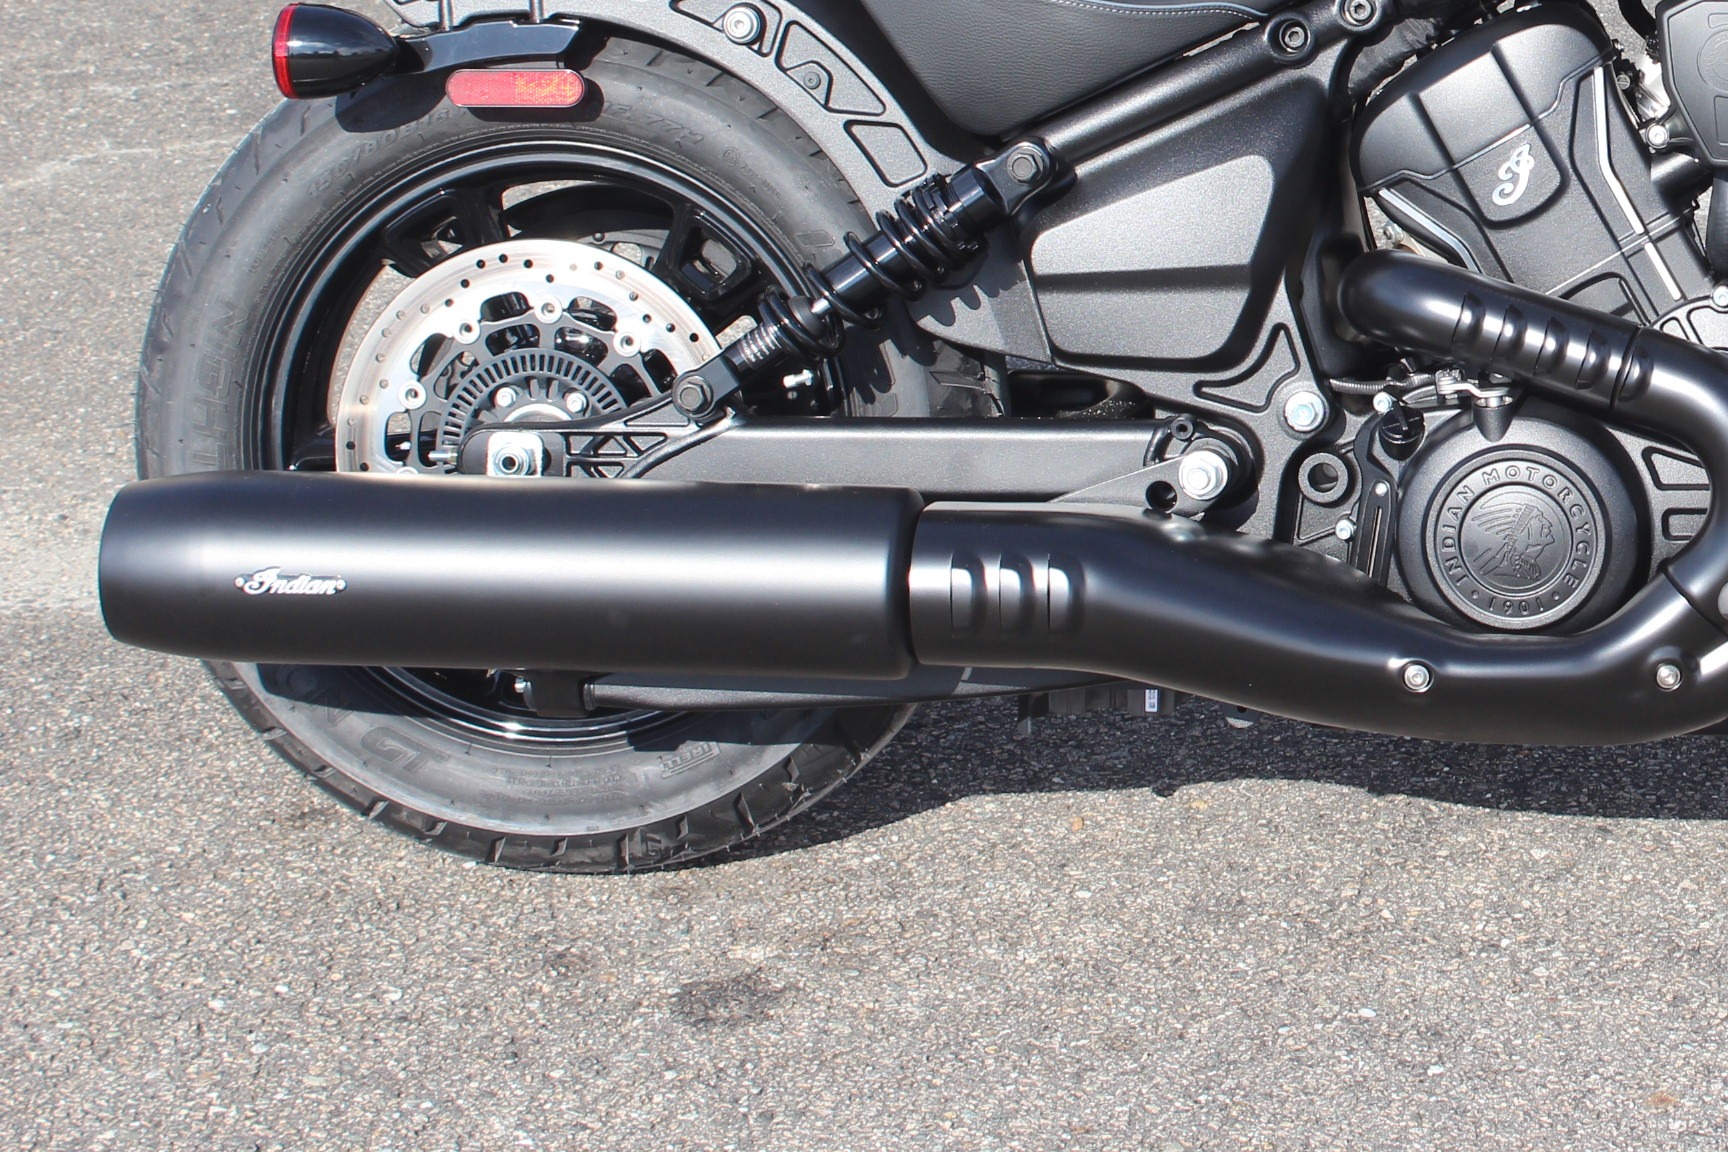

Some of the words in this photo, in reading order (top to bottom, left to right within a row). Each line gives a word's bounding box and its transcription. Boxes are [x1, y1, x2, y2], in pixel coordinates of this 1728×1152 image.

[1441, 484, 1476, 587] INDIAN
[1482, 464, 1592, 589] MOTORCYCLE
[243, 565, 338, 596] Indian
[1488, 596, 1545, 616] 1901
